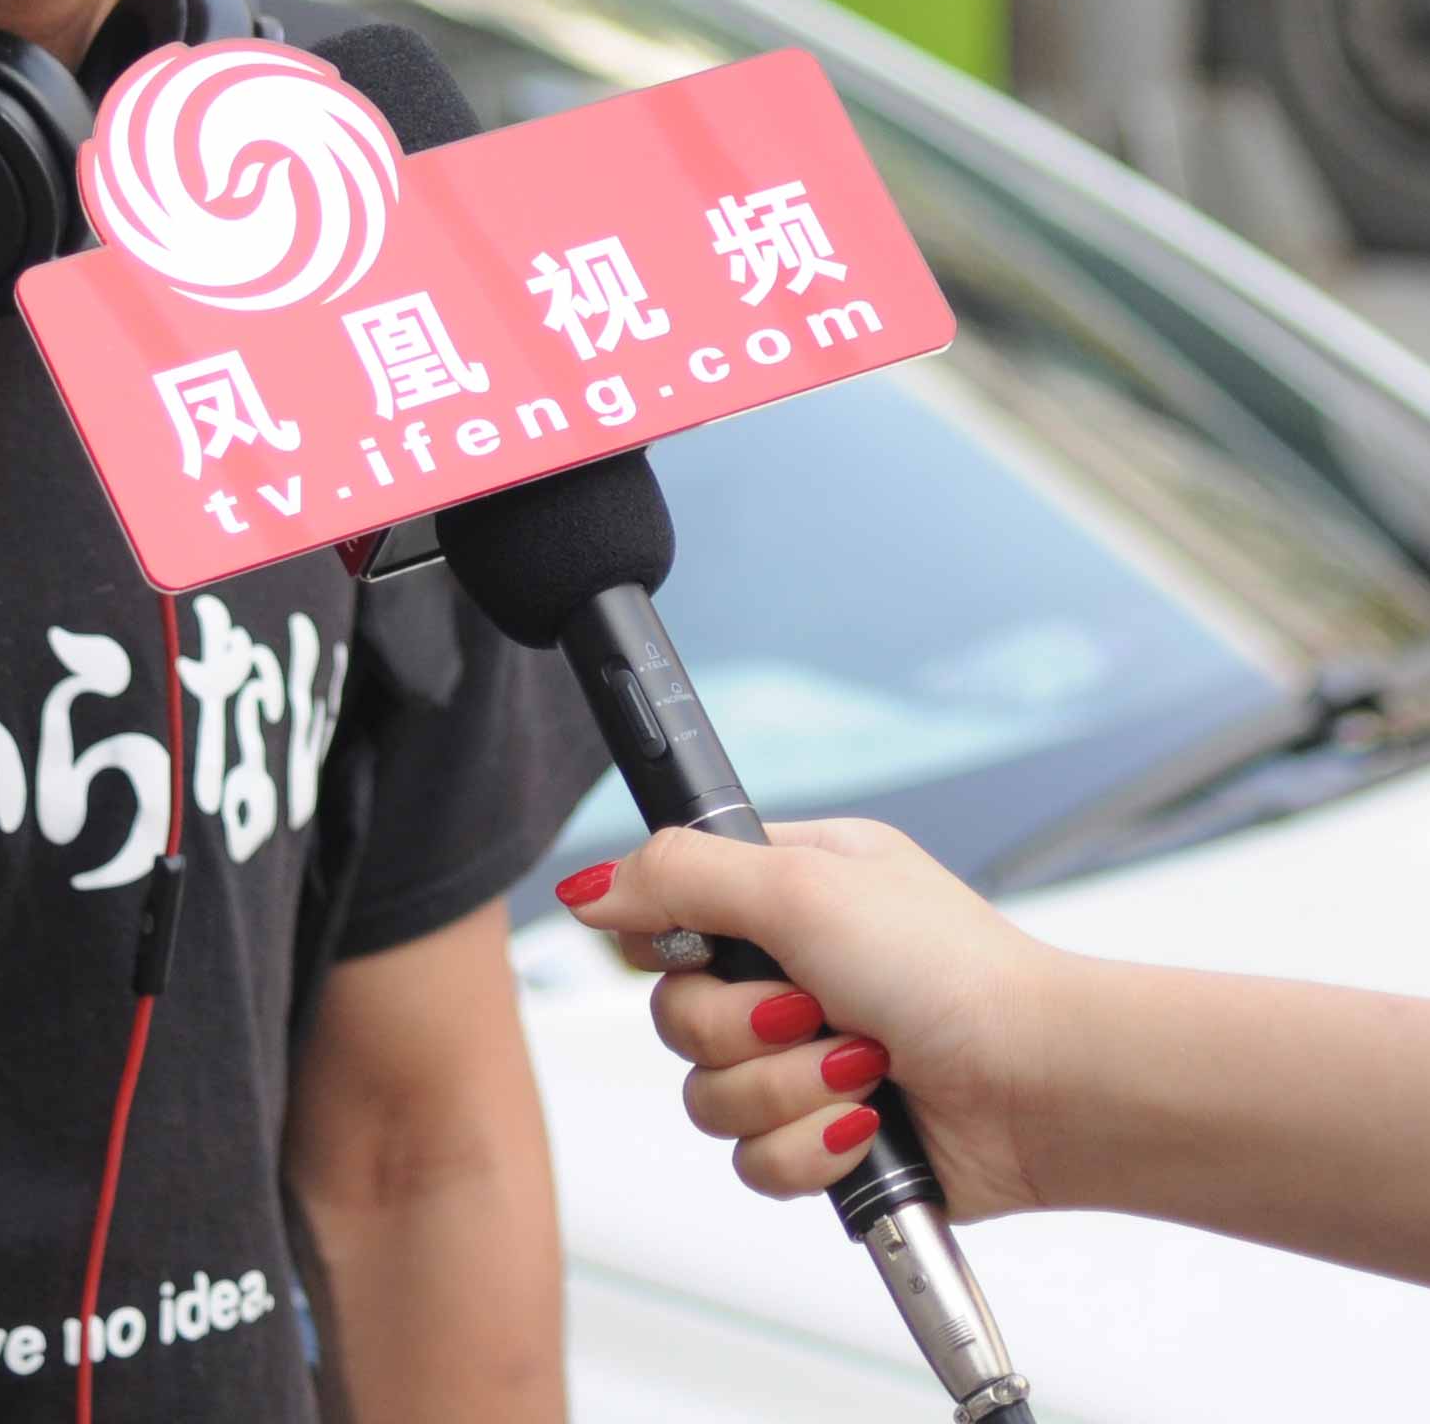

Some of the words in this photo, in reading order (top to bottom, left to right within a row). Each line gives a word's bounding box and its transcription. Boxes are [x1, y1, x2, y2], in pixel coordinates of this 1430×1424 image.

[151, 180, 848, 480] 凤凰视频
[204, 298, 882, 535] tv.ifeng.com
[63, 1305, 146, 1366] no
[159, 1270, 275, 1345] idea.
